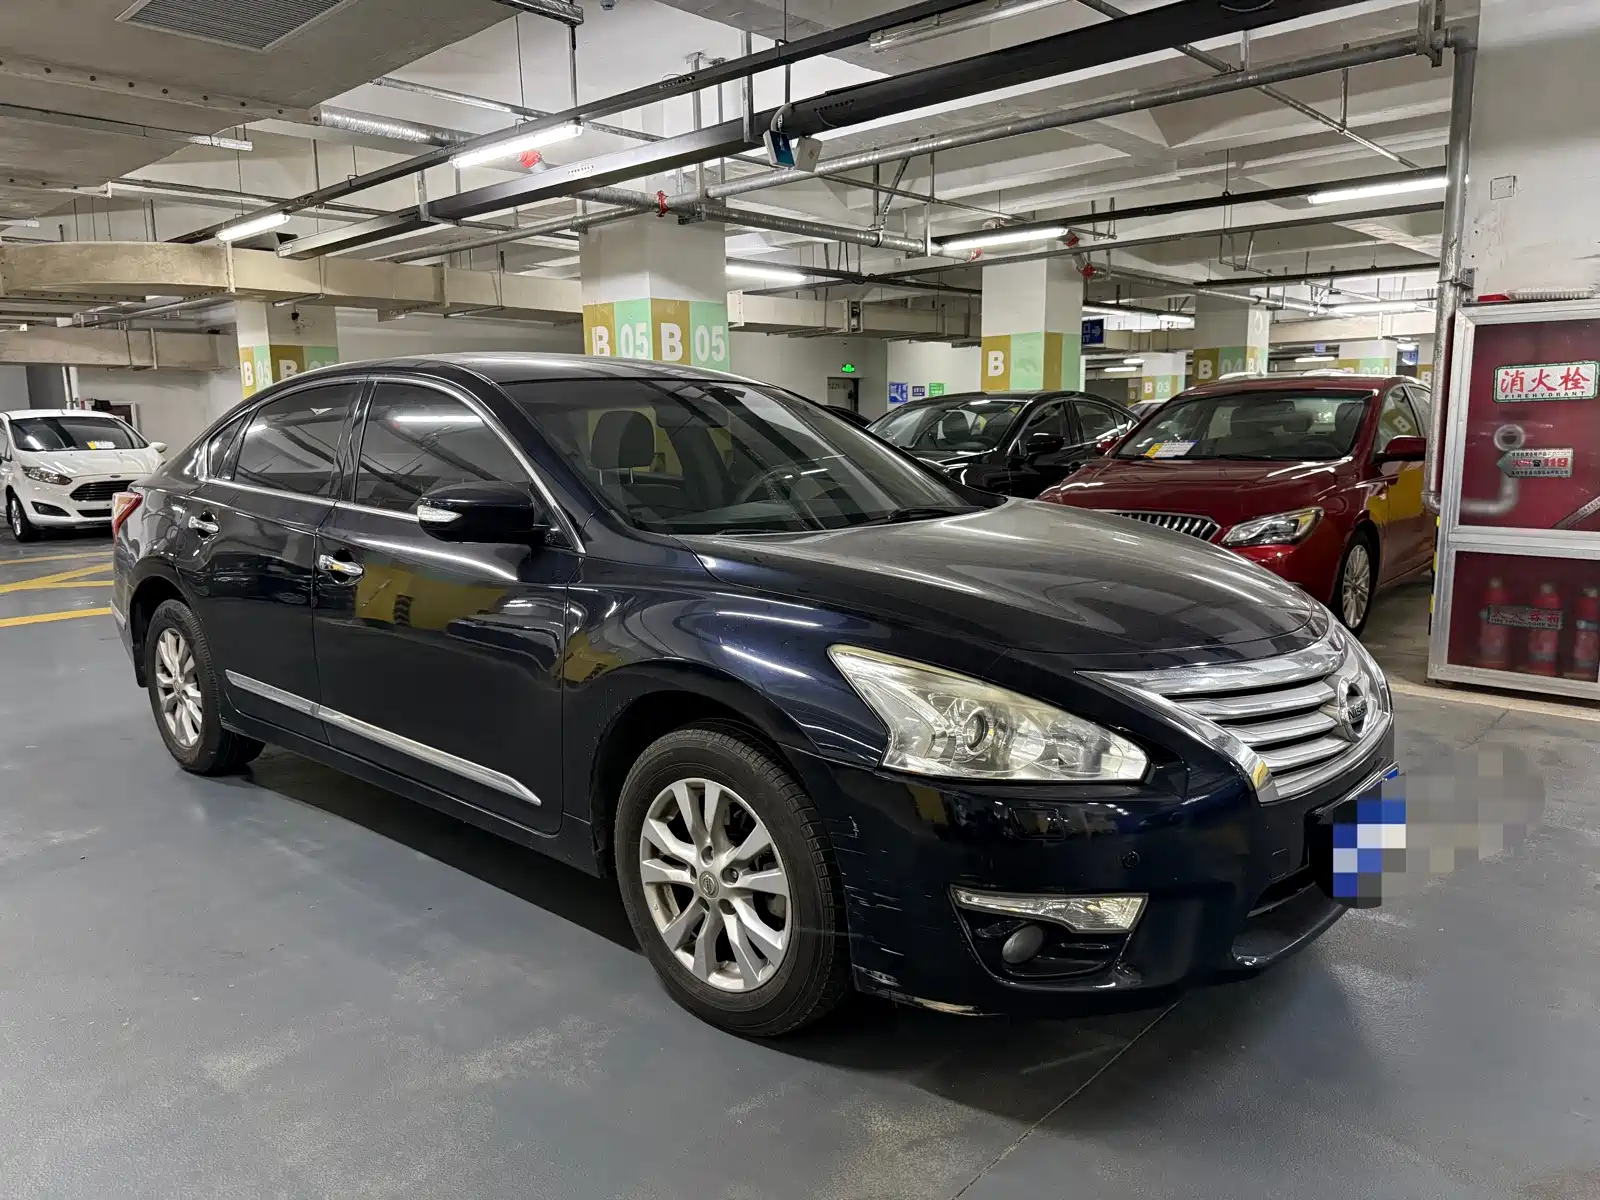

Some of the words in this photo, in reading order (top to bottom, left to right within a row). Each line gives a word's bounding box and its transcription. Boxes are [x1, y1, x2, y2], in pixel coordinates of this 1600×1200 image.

[591, 325, 611, 356] B
[620, 322, 649, 360] 05
[660, 322, 683, 361] B
[694, 324, 726, 362] 05
[243, 361, 254, 387] B
[279, 359, 298, 380] B
[988, 350, 1005, 377] B
[1197, 359, 1213, 380] B
[1144, 381, 1153, 394] B
[1156, 381, 1171, 394] 03
[1500, 366, 1590, 394] 消火栓
